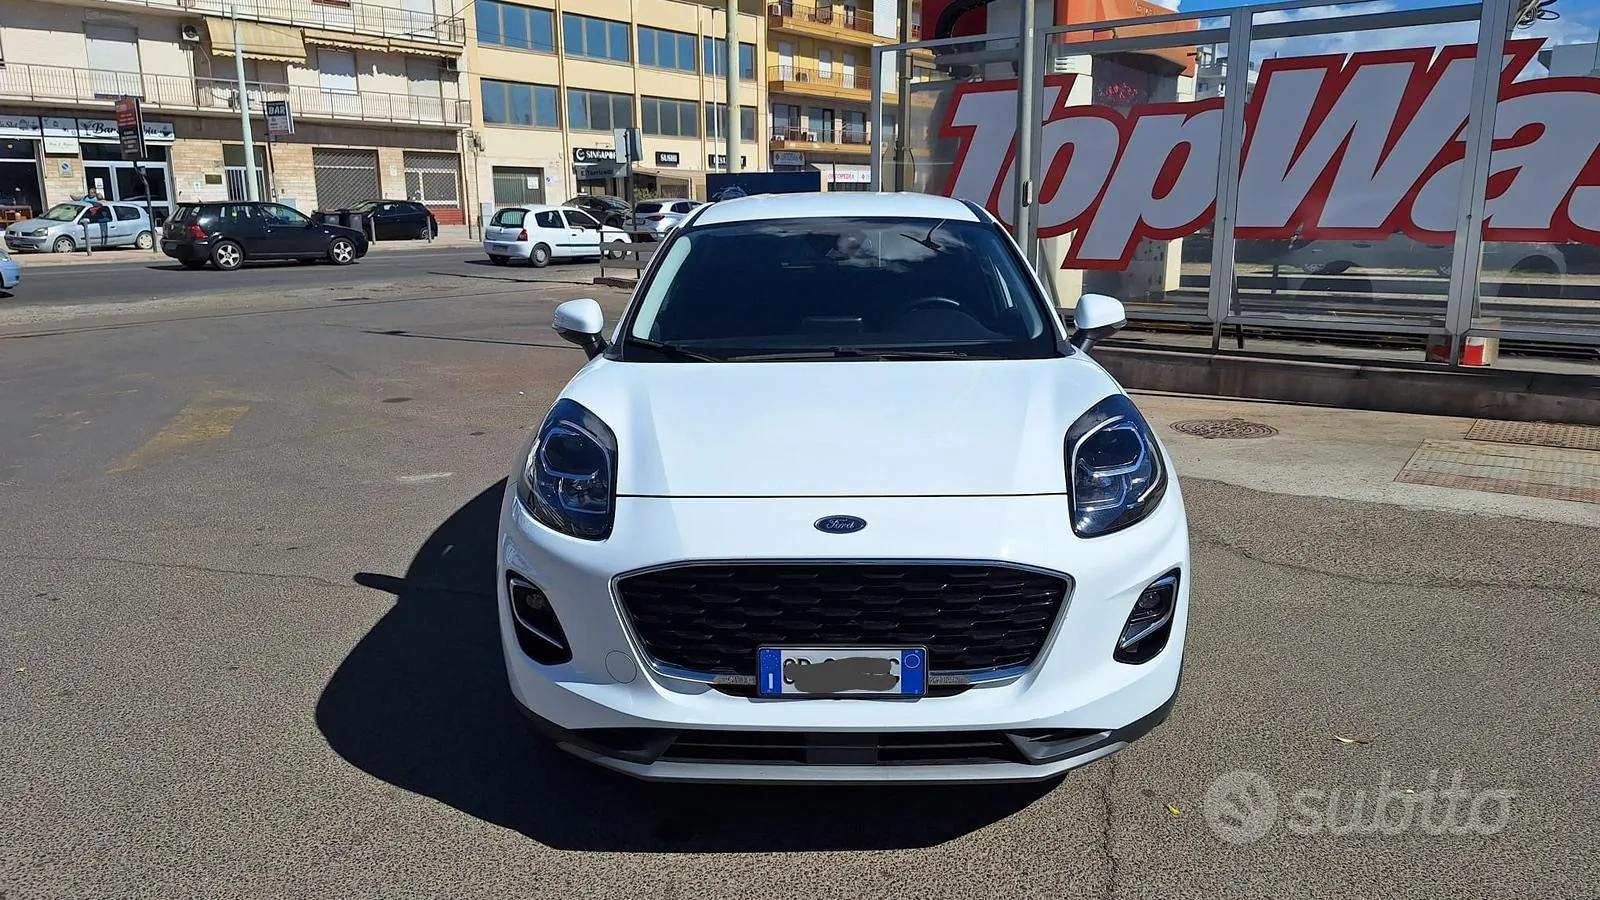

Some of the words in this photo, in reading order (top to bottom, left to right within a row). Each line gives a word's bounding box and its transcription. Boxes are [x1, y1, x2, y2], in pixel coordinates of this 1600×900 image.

[268, 106, 286, 115] BAR
[660, 153, 678, 162] SUSHI
[938, 38, 1600, 270] TopWa
[826, 519, 855, 529] Ford
